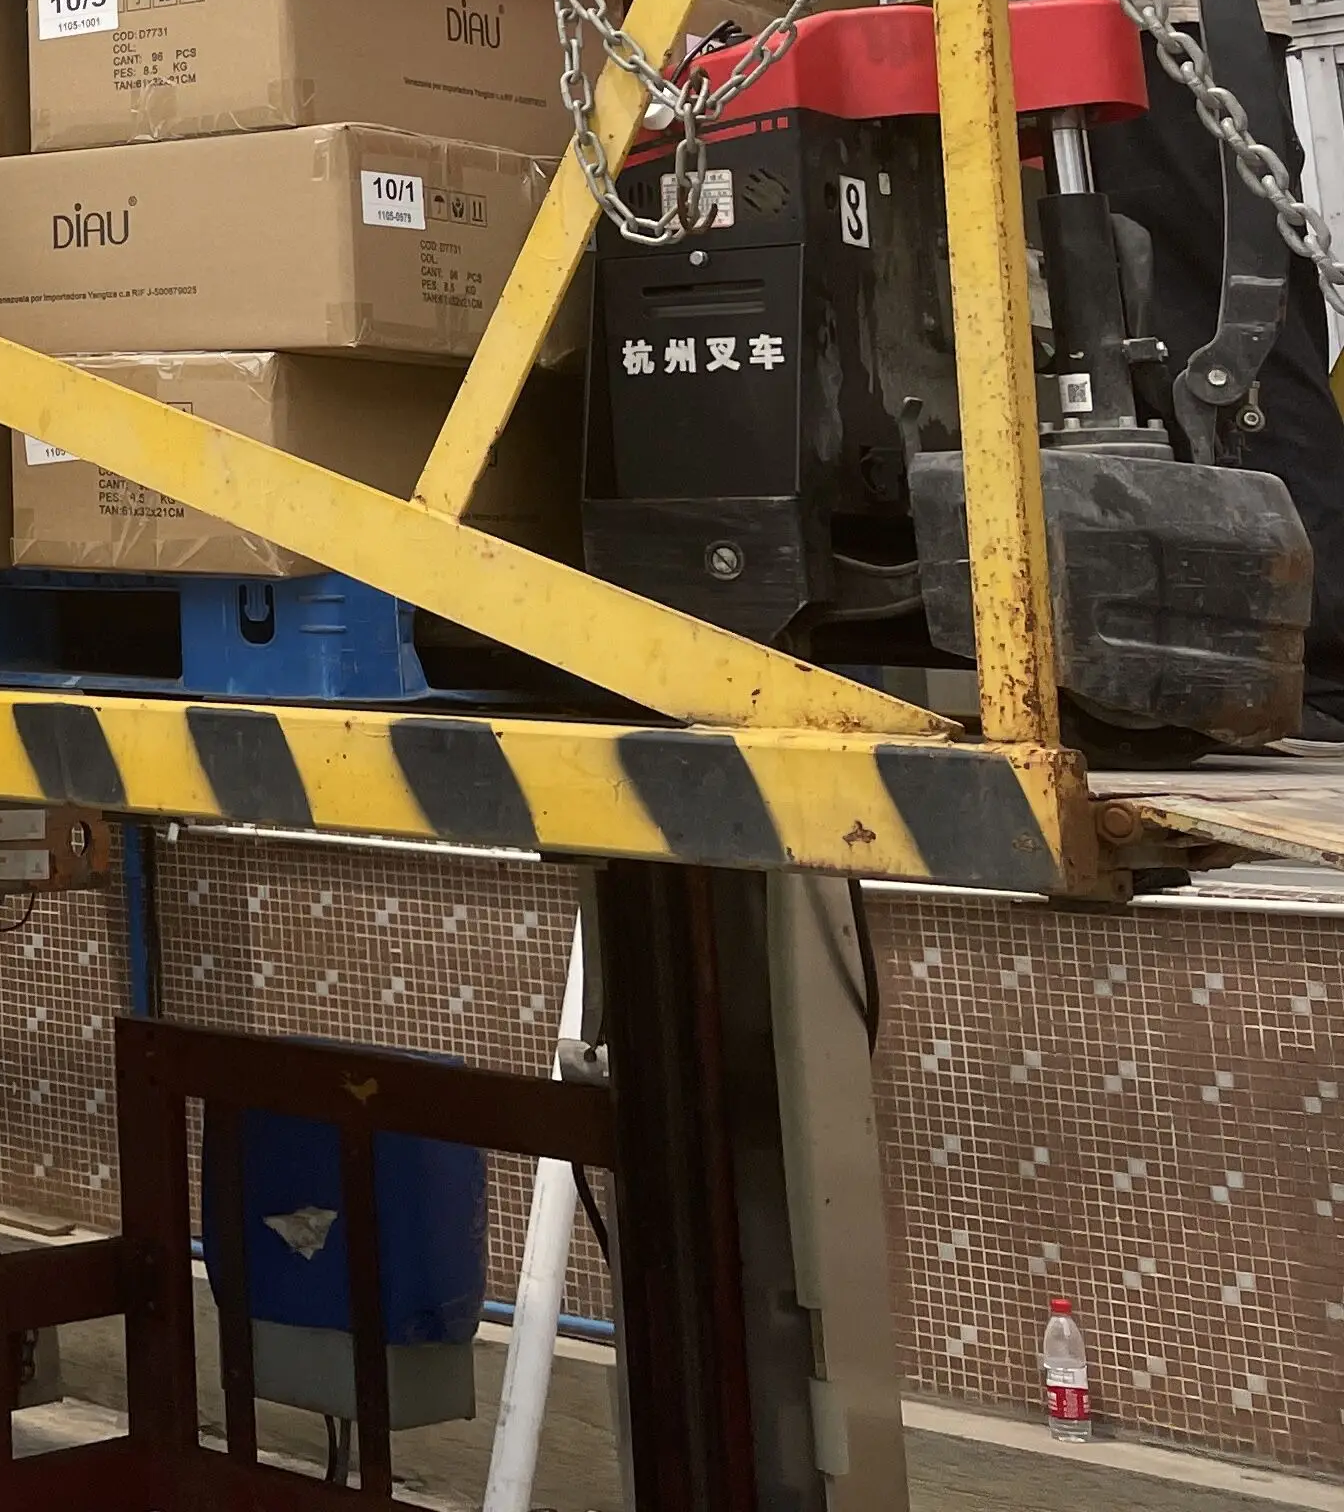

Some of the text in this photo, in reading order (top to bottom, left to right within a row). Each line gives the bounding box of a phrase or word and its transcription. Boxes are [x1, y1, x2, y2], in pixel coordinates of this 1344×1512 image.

[58, 16, 101, 33] 1105-1001
[113, 26, 169, 41] COD: D7731
[113, 54, 143, 67] CANT:
[175, 47, 197, 60] PCS
[113, 68, 137, 79] PES:
[173, 61, 188, 73] KG
[372, 176, 415, 203] 10/1
[622, 333, 786, 376] 杭州叉车
